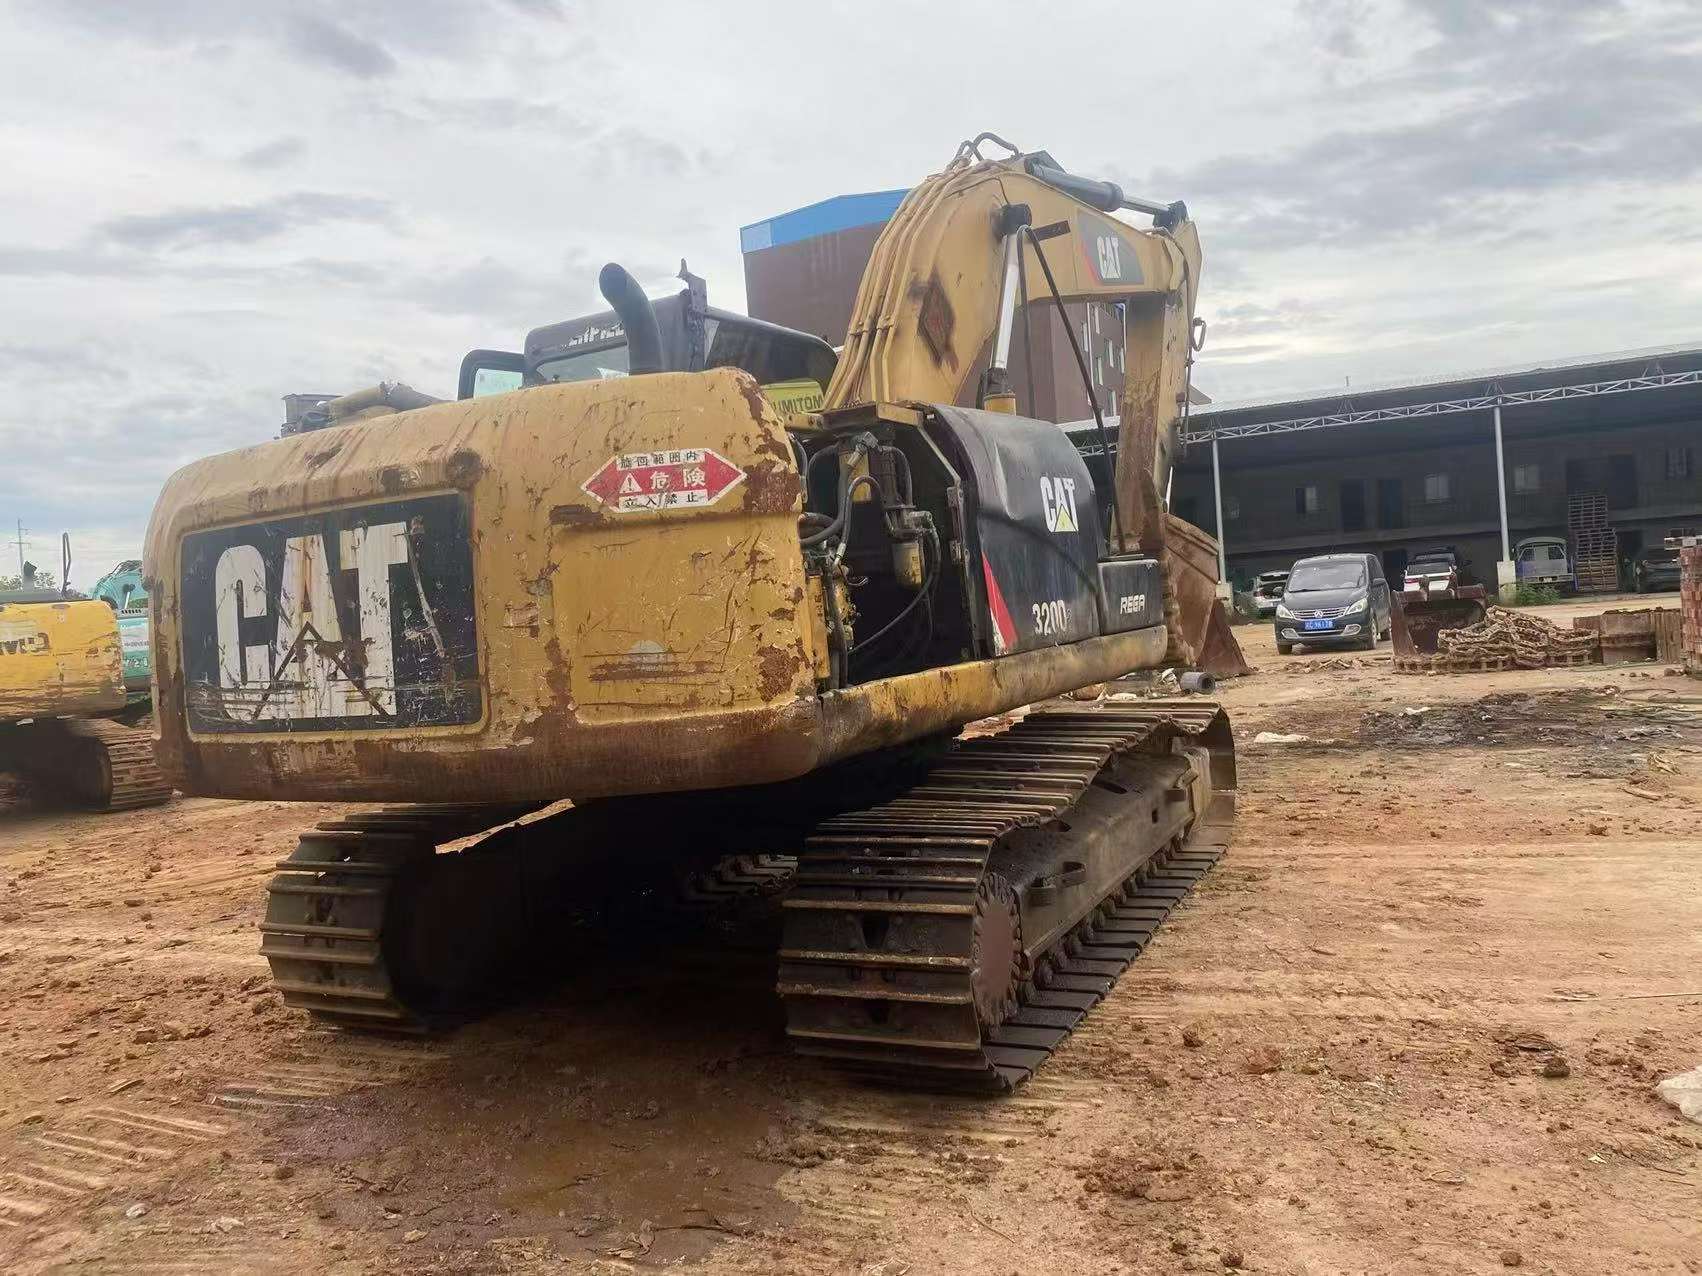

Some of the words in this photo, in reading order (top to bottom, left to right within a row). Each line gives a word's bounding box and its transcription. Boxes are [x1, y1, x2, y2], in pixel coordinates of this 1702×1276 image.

[1096, 236, 1121, 279] CAT
[650, 465, 707, 490] 危険
[1040, 476, 1079, 533] CAT
[215, 521, 409, 722] CAT
